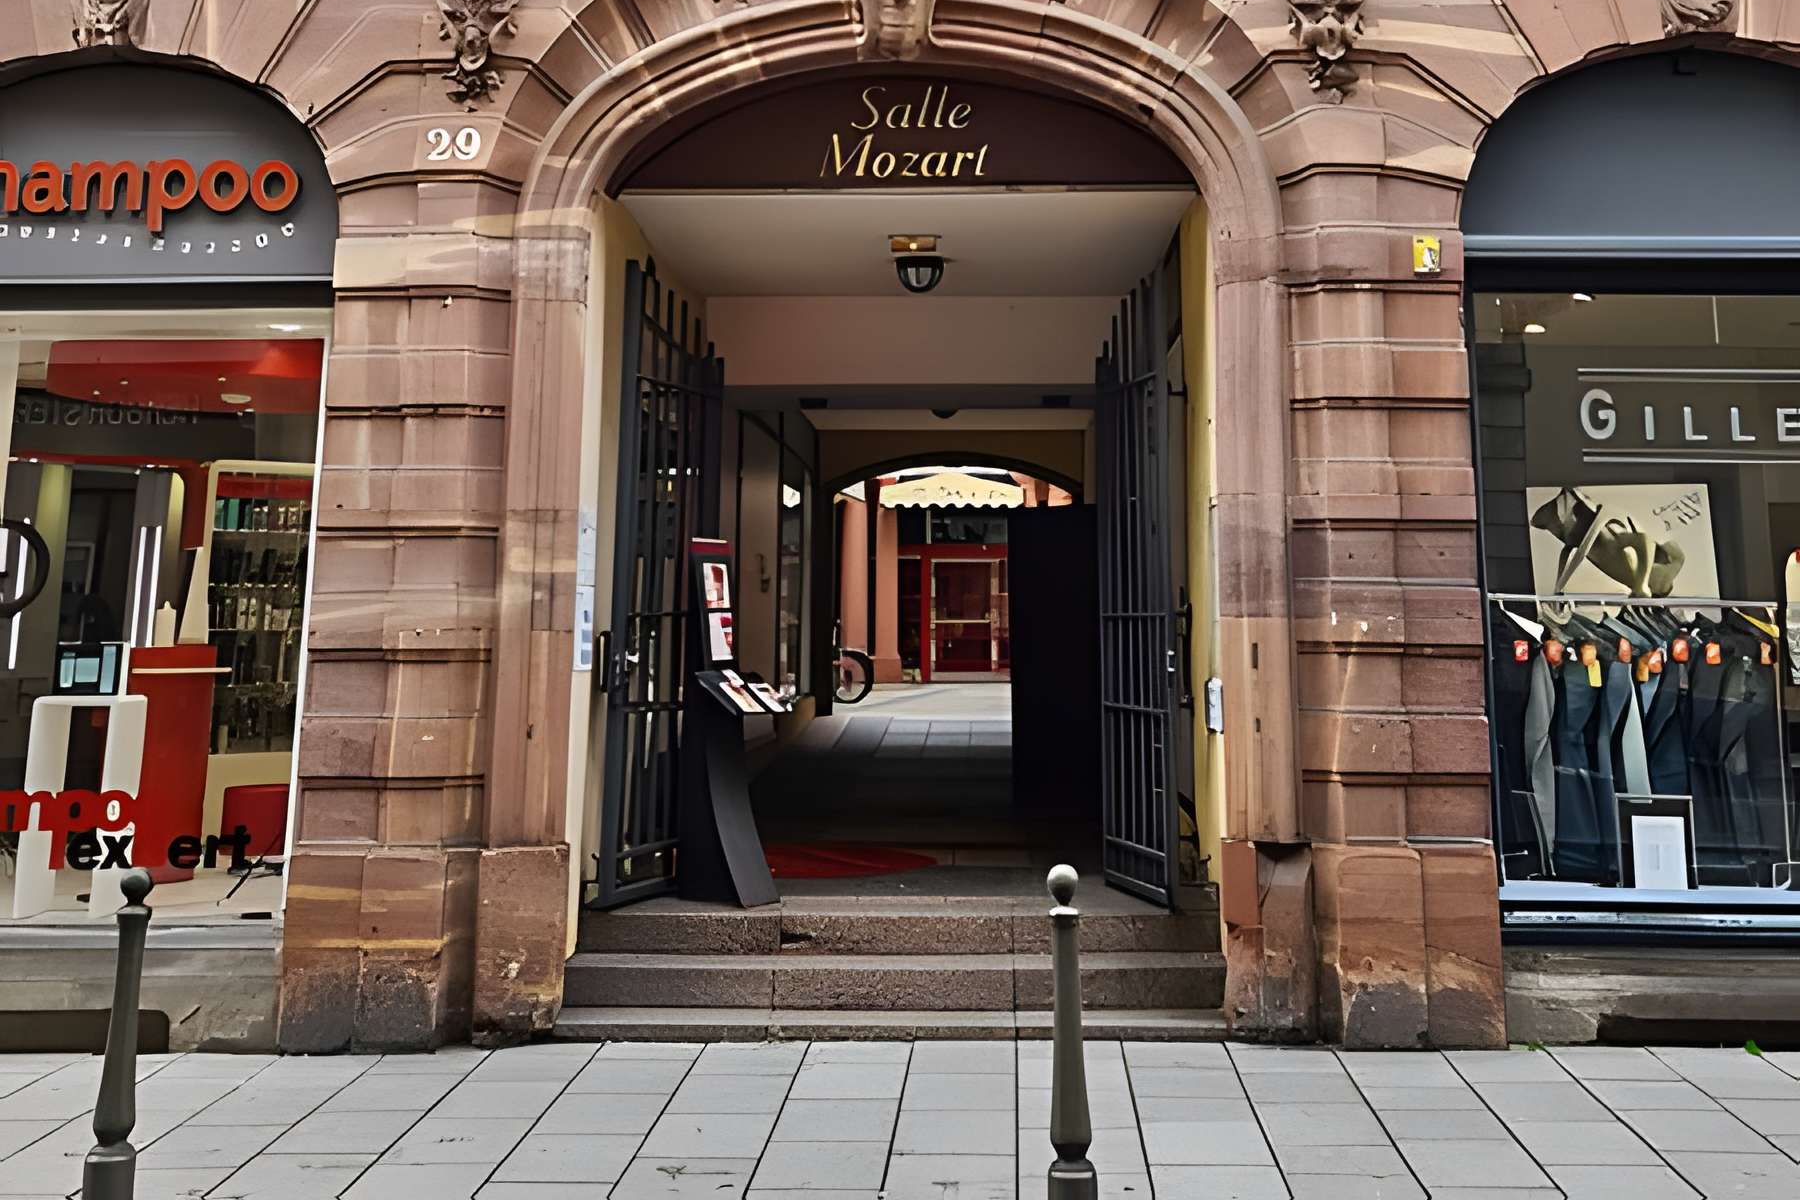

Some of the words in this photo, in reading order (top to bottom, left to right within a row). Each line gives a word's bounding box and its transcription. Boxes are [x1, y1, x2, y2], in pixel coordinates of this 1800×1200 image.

[851, 85, 971, 130] Salle
[819, 133, 989, 179] Mozart
[1580, 388, 1800, 443] GILLE
